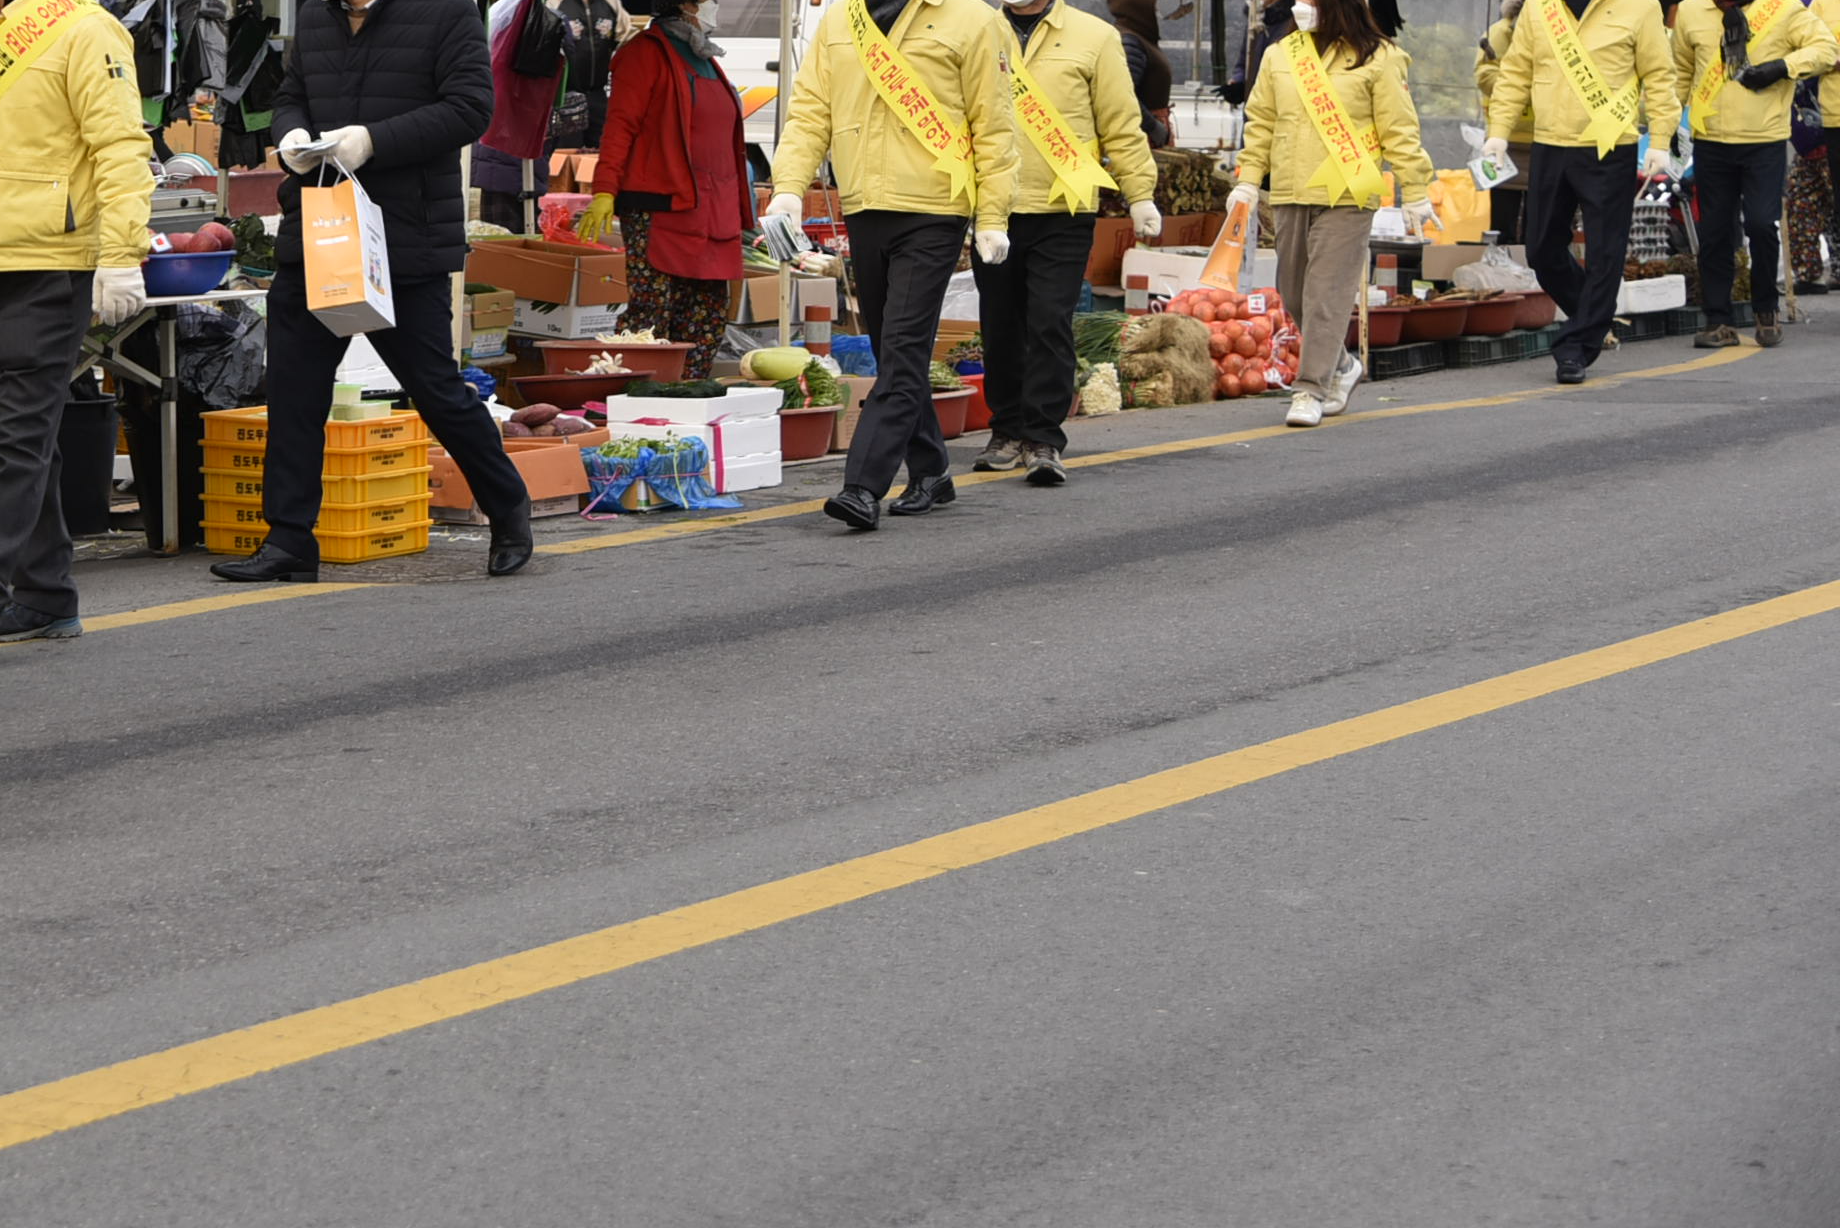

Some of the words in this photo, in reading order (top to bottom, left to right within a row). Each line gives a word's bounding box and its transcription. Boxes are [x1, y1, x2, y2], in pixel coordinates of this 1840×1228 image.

[5, 16, 44, 57] 있으면
[865, 43, 891, 72] 우리
[879, 64, 909, 93] 모두
[897, 86, 930, 117] 함께
[1311, 92, 1336, 115] 함께
